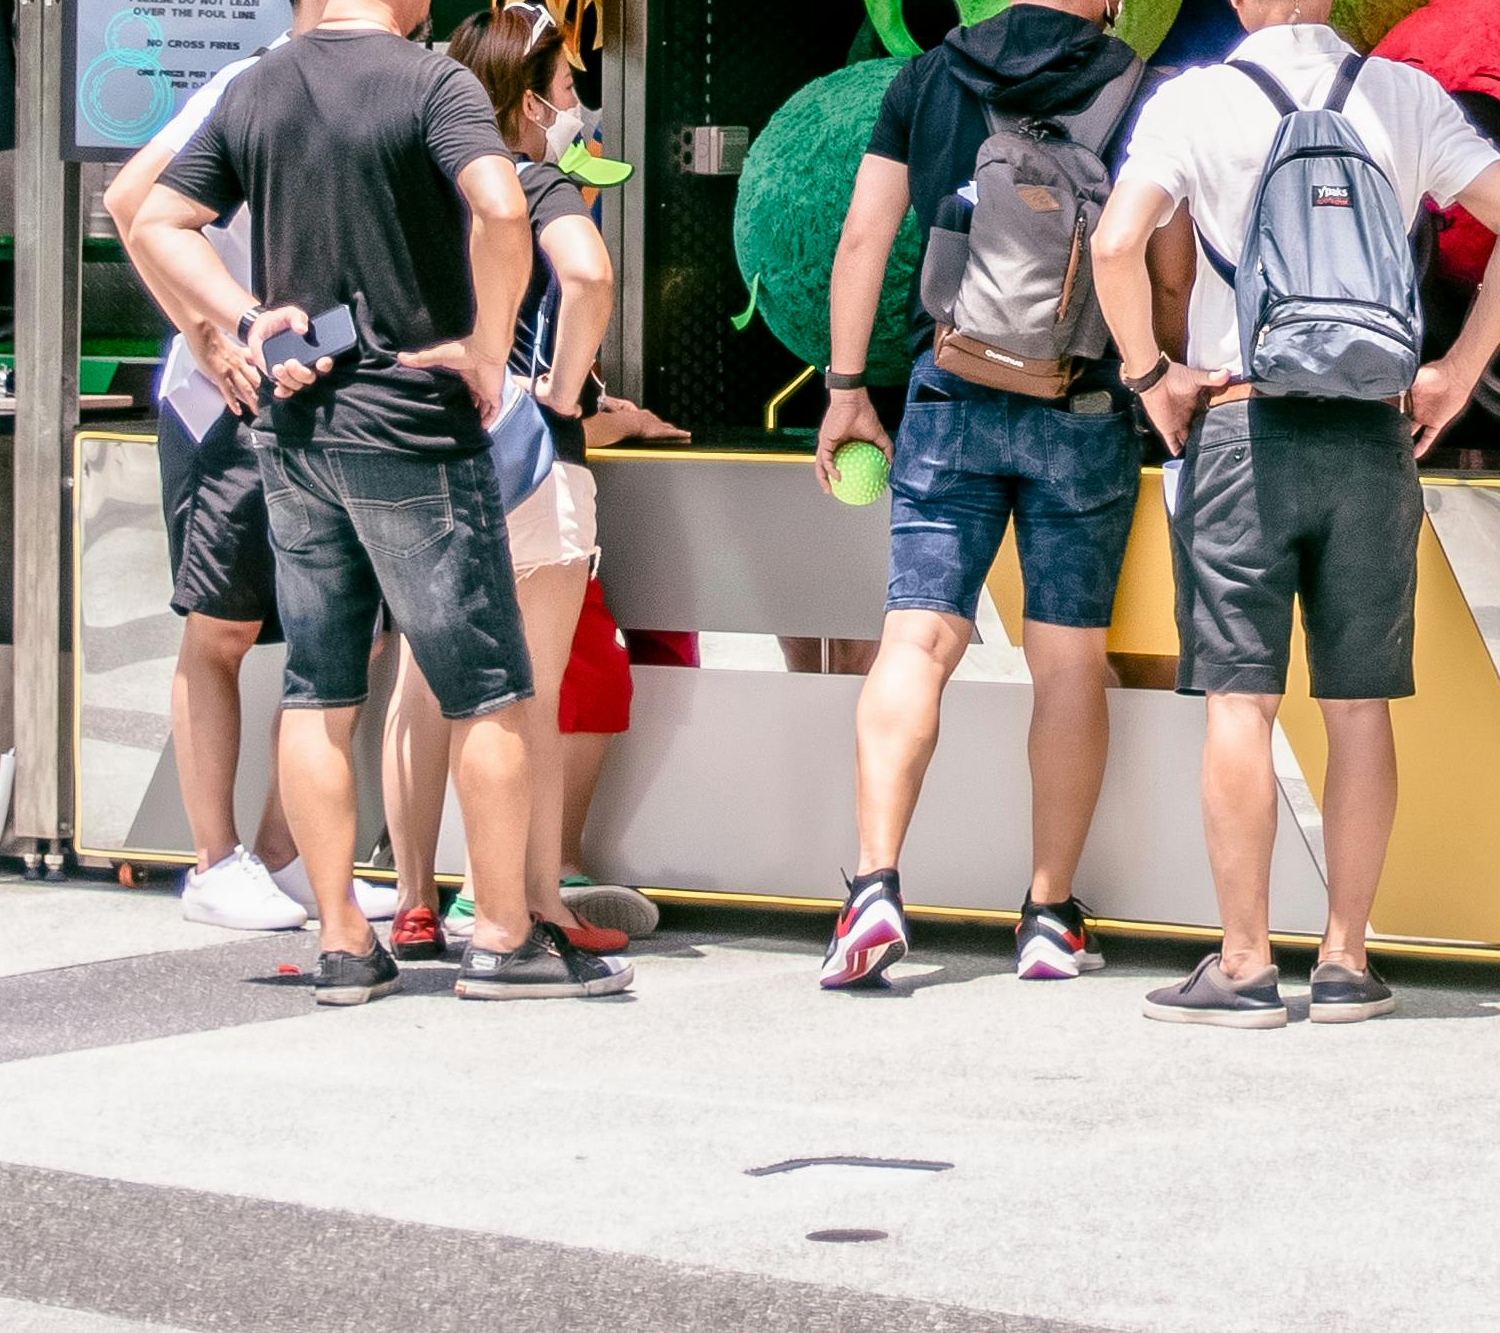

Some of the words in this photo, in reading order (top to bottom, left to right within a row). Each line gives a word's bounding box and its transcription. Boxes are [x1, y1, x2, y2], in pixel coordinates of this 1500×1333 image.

[133, 7, 166, 17] OVER
[171, 8, 192, 18] THE
[198, 9, 227, 19] FOUL
[232, 10, 256, 20] LINE
[147, 39, 163, 48] NO
[167, 39, 205, 49] CROSS
[209, 41, 240, 51] FIRES
[189, 70, 207, 78] PER
[171, 81, 188, 89] PER
